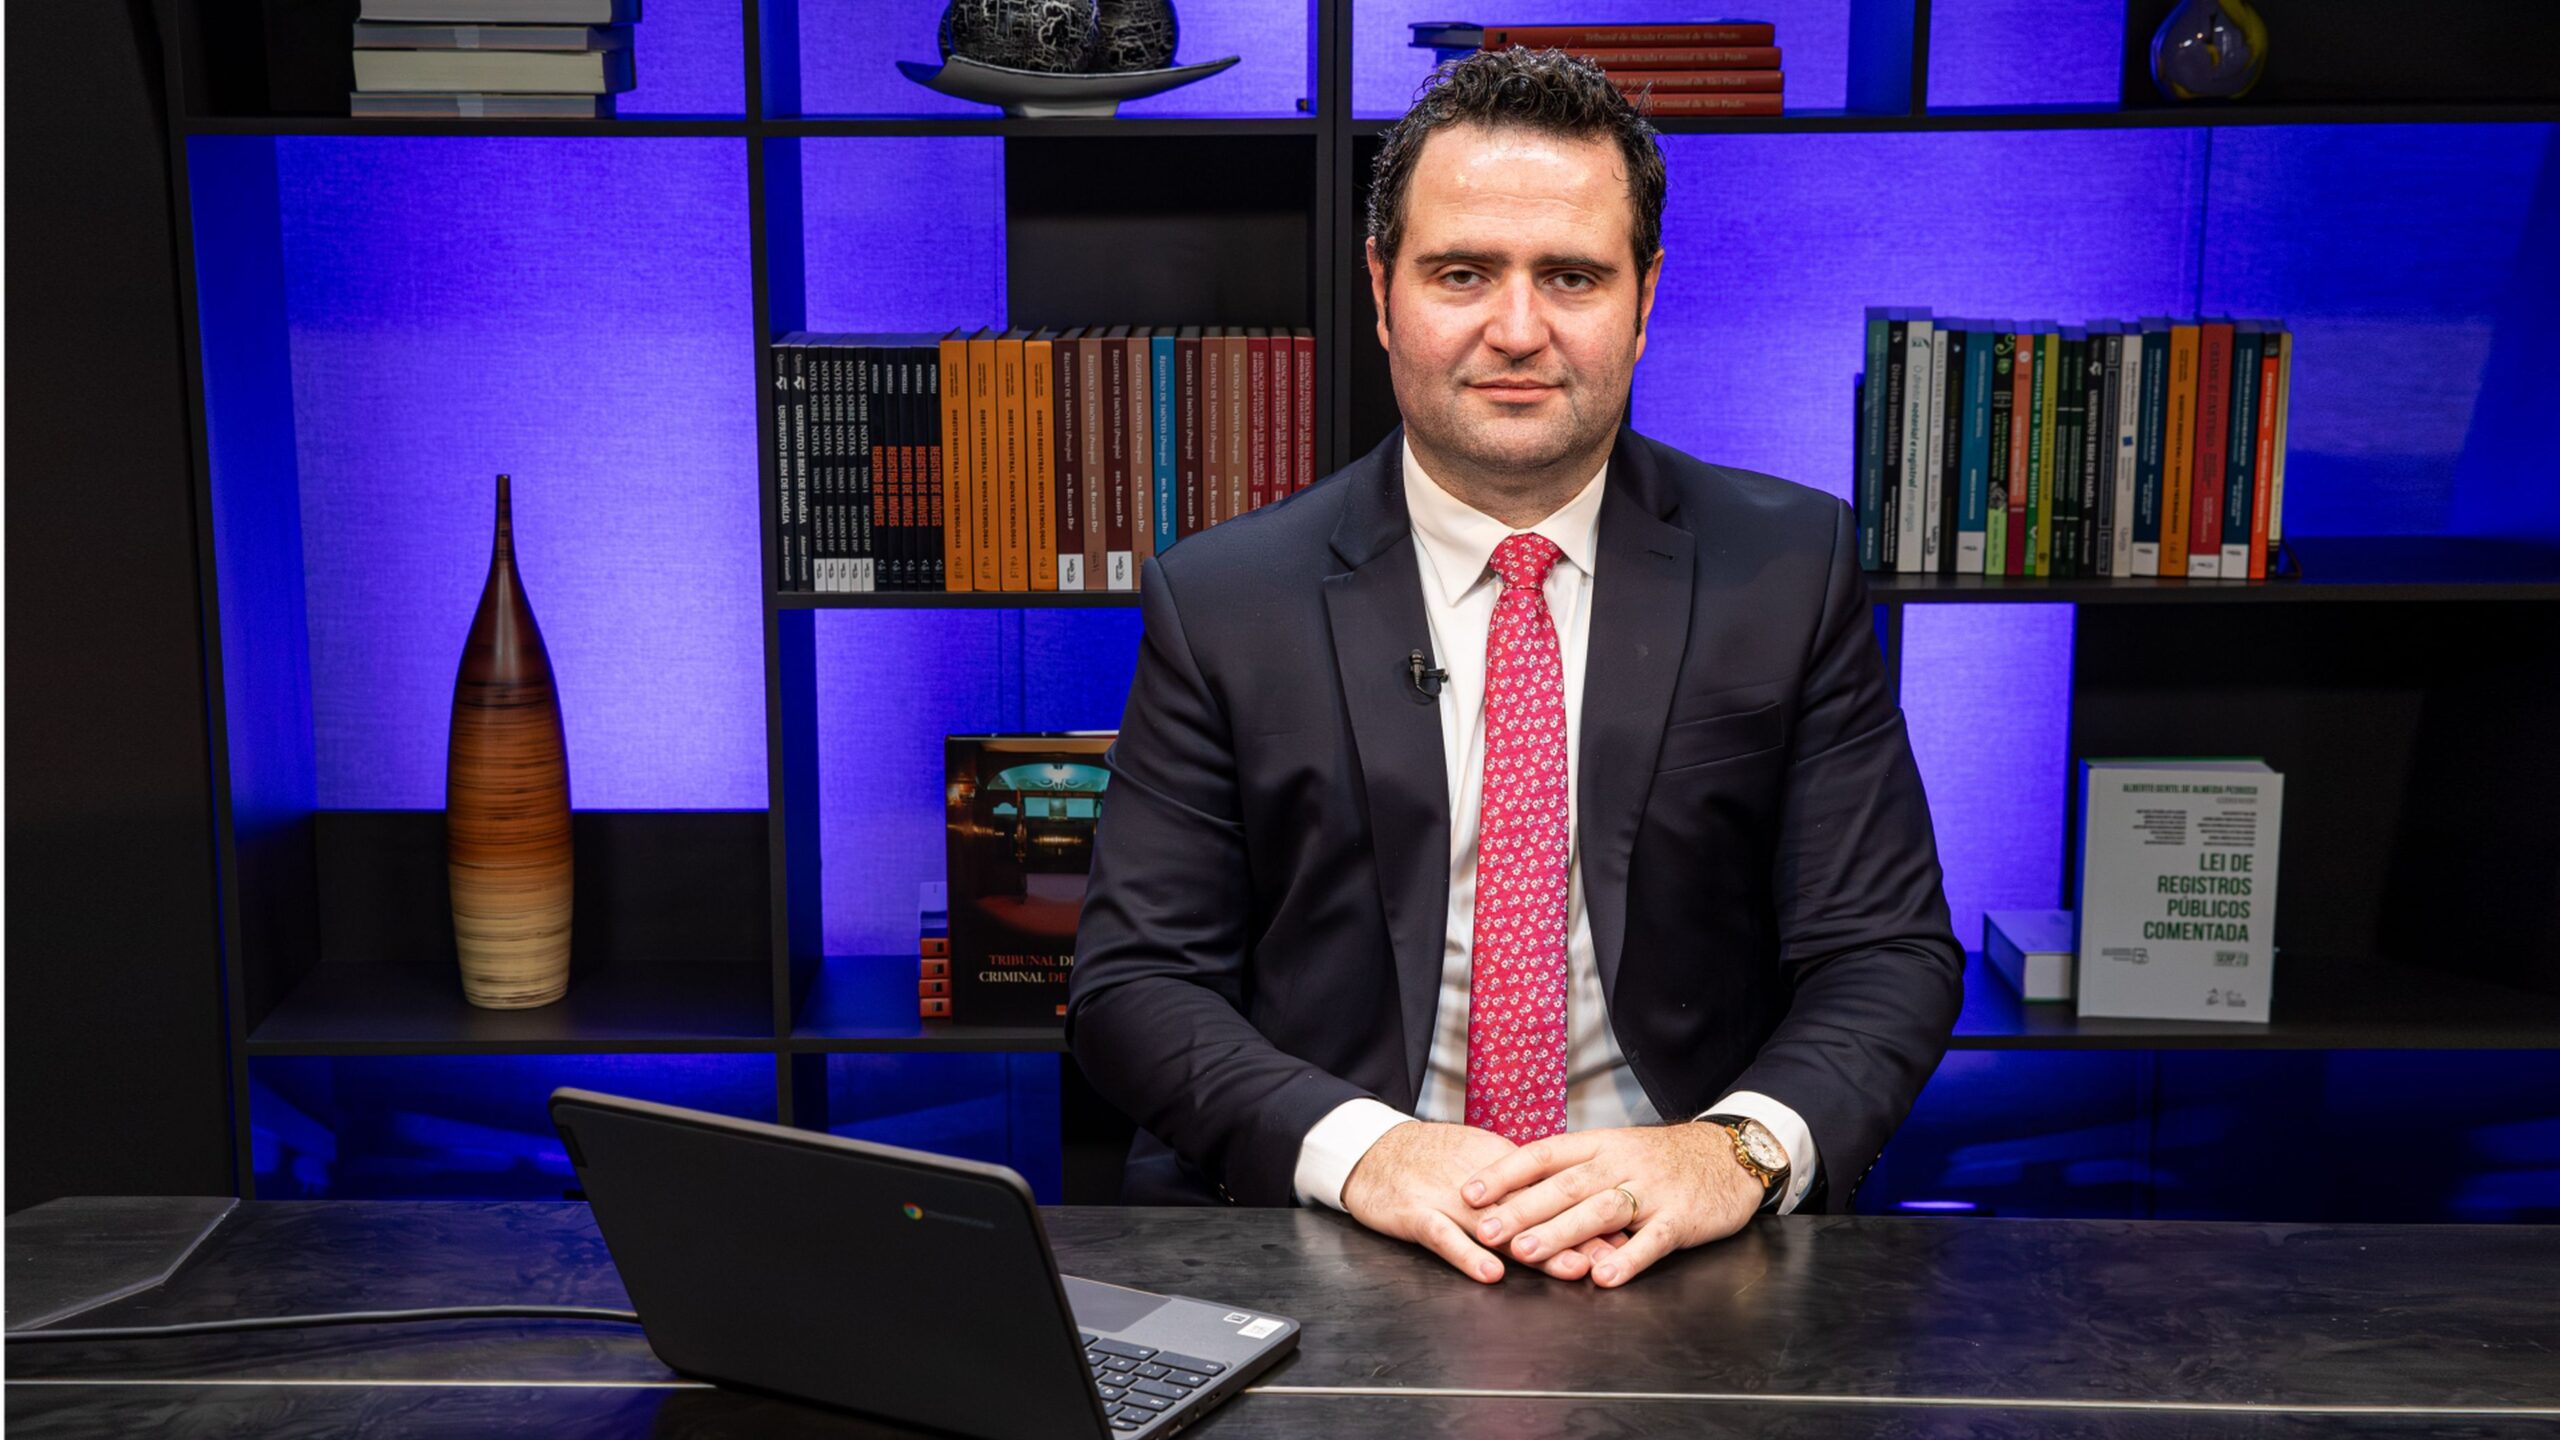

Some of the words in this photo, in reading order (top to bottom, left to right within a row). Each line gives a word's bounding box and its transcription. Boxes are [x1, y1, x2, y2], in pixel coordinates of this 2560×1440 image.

[809, 361, 818, 392] NOTAS
[821, 361, 830, 392] NOTAS
[833, 361, 842, 392] NOTAS
[845, 361, 854, 392] NOTAS
[857, 361, 866, 392] NOTAS
[810, 394, 819, 422] SOBRE
[822, 394, 831, 422] SOBRE
[834, 394, 843, 422] SOBRE
[846, 394, 856, 422] SOBRE
[859, 394, 868, 422] SOBRE
[778, 405, 787, 450] USUFRUTO
[795, 405, 804, 450] USUFRUTO
[811, 425, 820, 456] NOTAS
[823, 425, 832, 456] NOTAS
[835, 425, 844, 456] NOTAS
[847, 425, 857, 456] NOTAS
[859, 425, 869, 456] NOTAS
[780, 458, 788, 476] BEM
[797, 458, 805, 476] BEM
[872, 446, 882, 483] REGISTRO
[887, 446, 897, 483] REGISTRO
[901, 446, 912, 483] REGISTRO
[915, 446, 926, 483] REGISTRO
[930, 446, 941, 483] REGISTRO
[781, 478, 788, 489] DE
[798, 478, 806, 489] DE
[873, 484, 883, 494] DE
[887, 484, 898, 494] DE
[902, 484, 912, 494] DE
[916, 484, 927, 494] DE
[930, 484, 941, 494] DE
[2200, 853, 2226, 871] LEI
[2231, 854, 2253, 872] DE
[2157, 875, 2252, 896] REGISTROS
[2167, 896, 2251, 918] PÚBLICOS
[2144, 921, 2249, 942] COMENTADA
[988, 955, 1056, 966] TRIBUNAL
[979, 972, 1045, 983] CRIMINAL
[1048, 972, 1066, 983] DE
